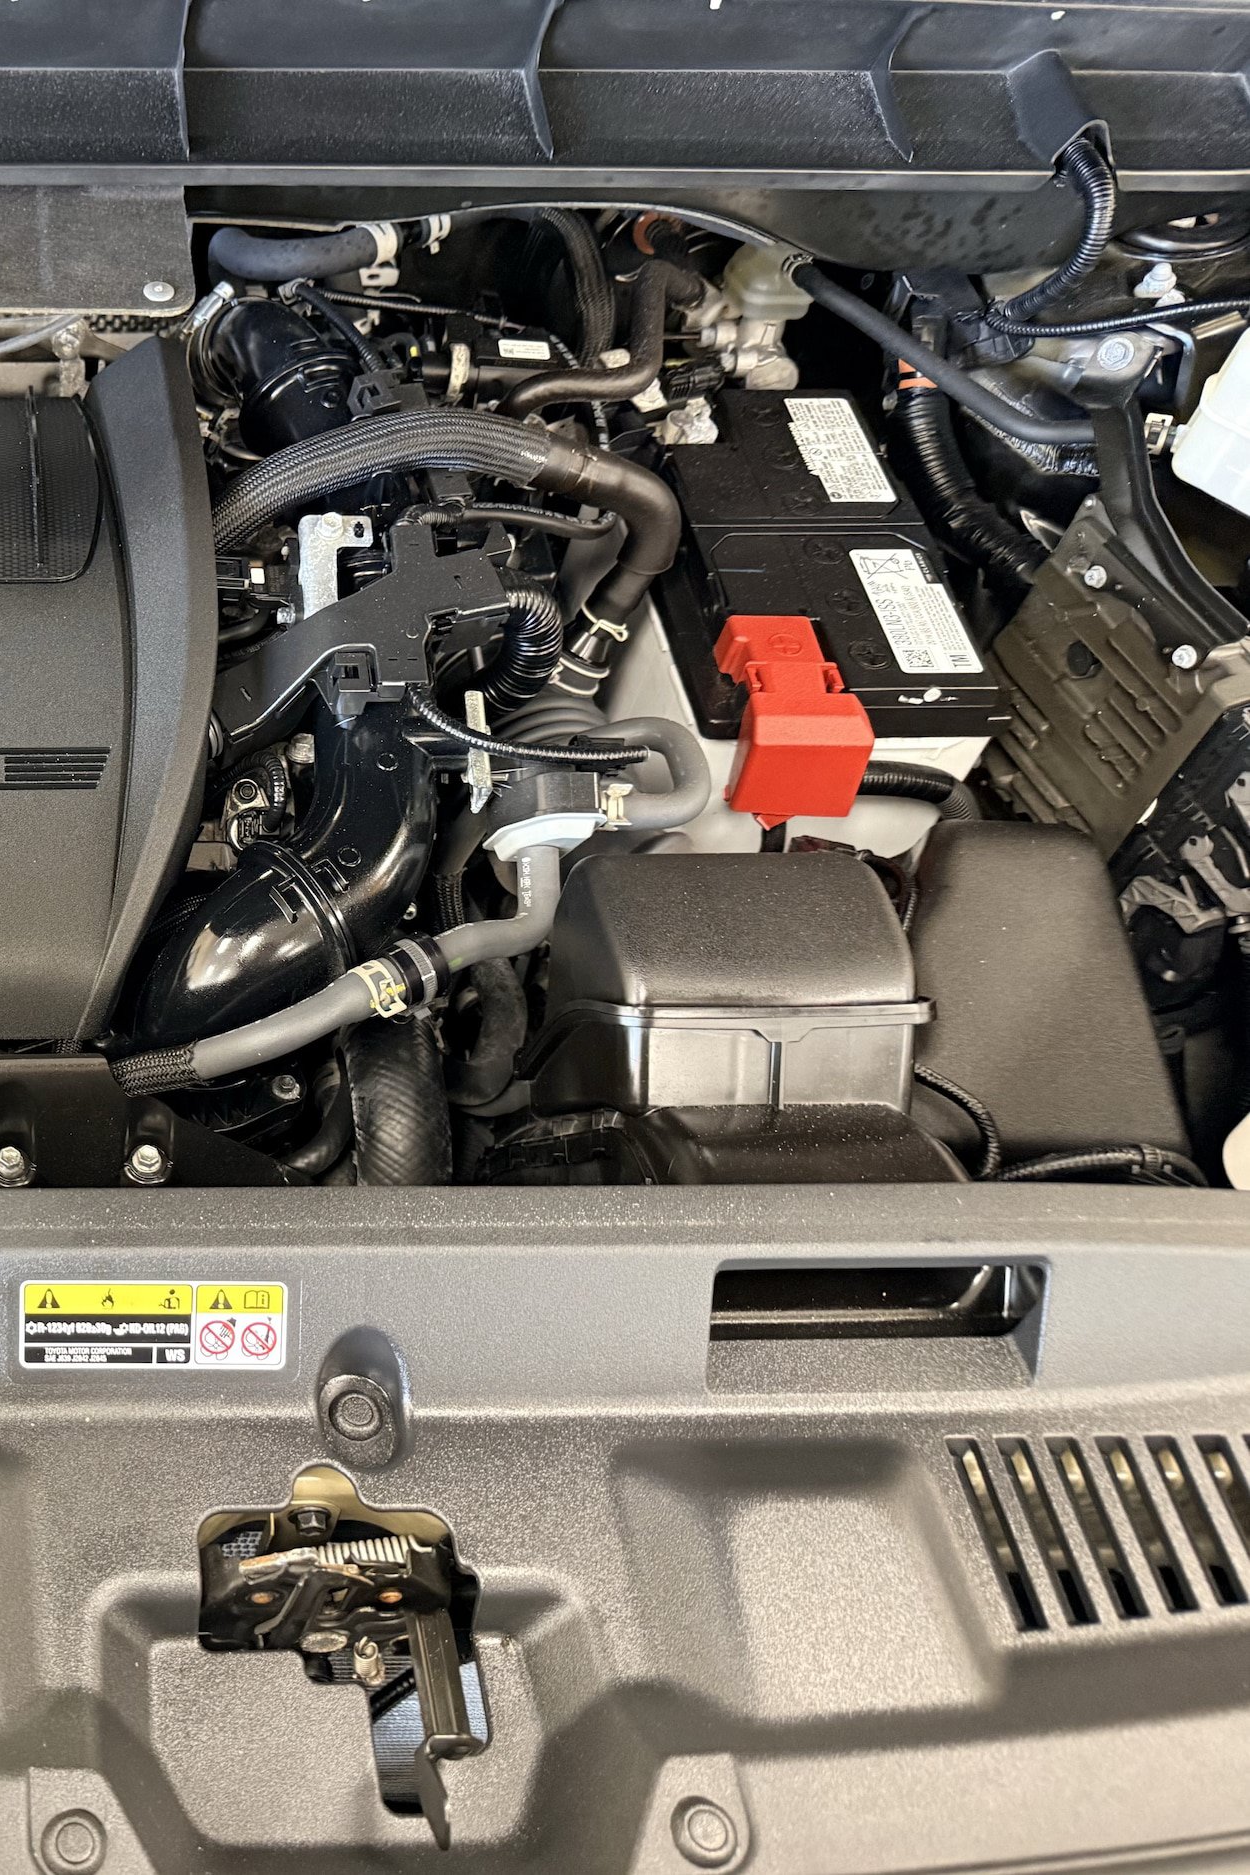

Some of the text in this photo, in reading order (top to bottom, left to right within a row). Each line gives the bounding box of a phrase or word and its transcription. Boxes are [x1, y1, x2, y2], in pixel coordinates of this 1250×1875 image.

[45, 1346, 133, 1356] TOYOTA MOTOR CORPORATION
[165, 1348, 186, 1362] WS
